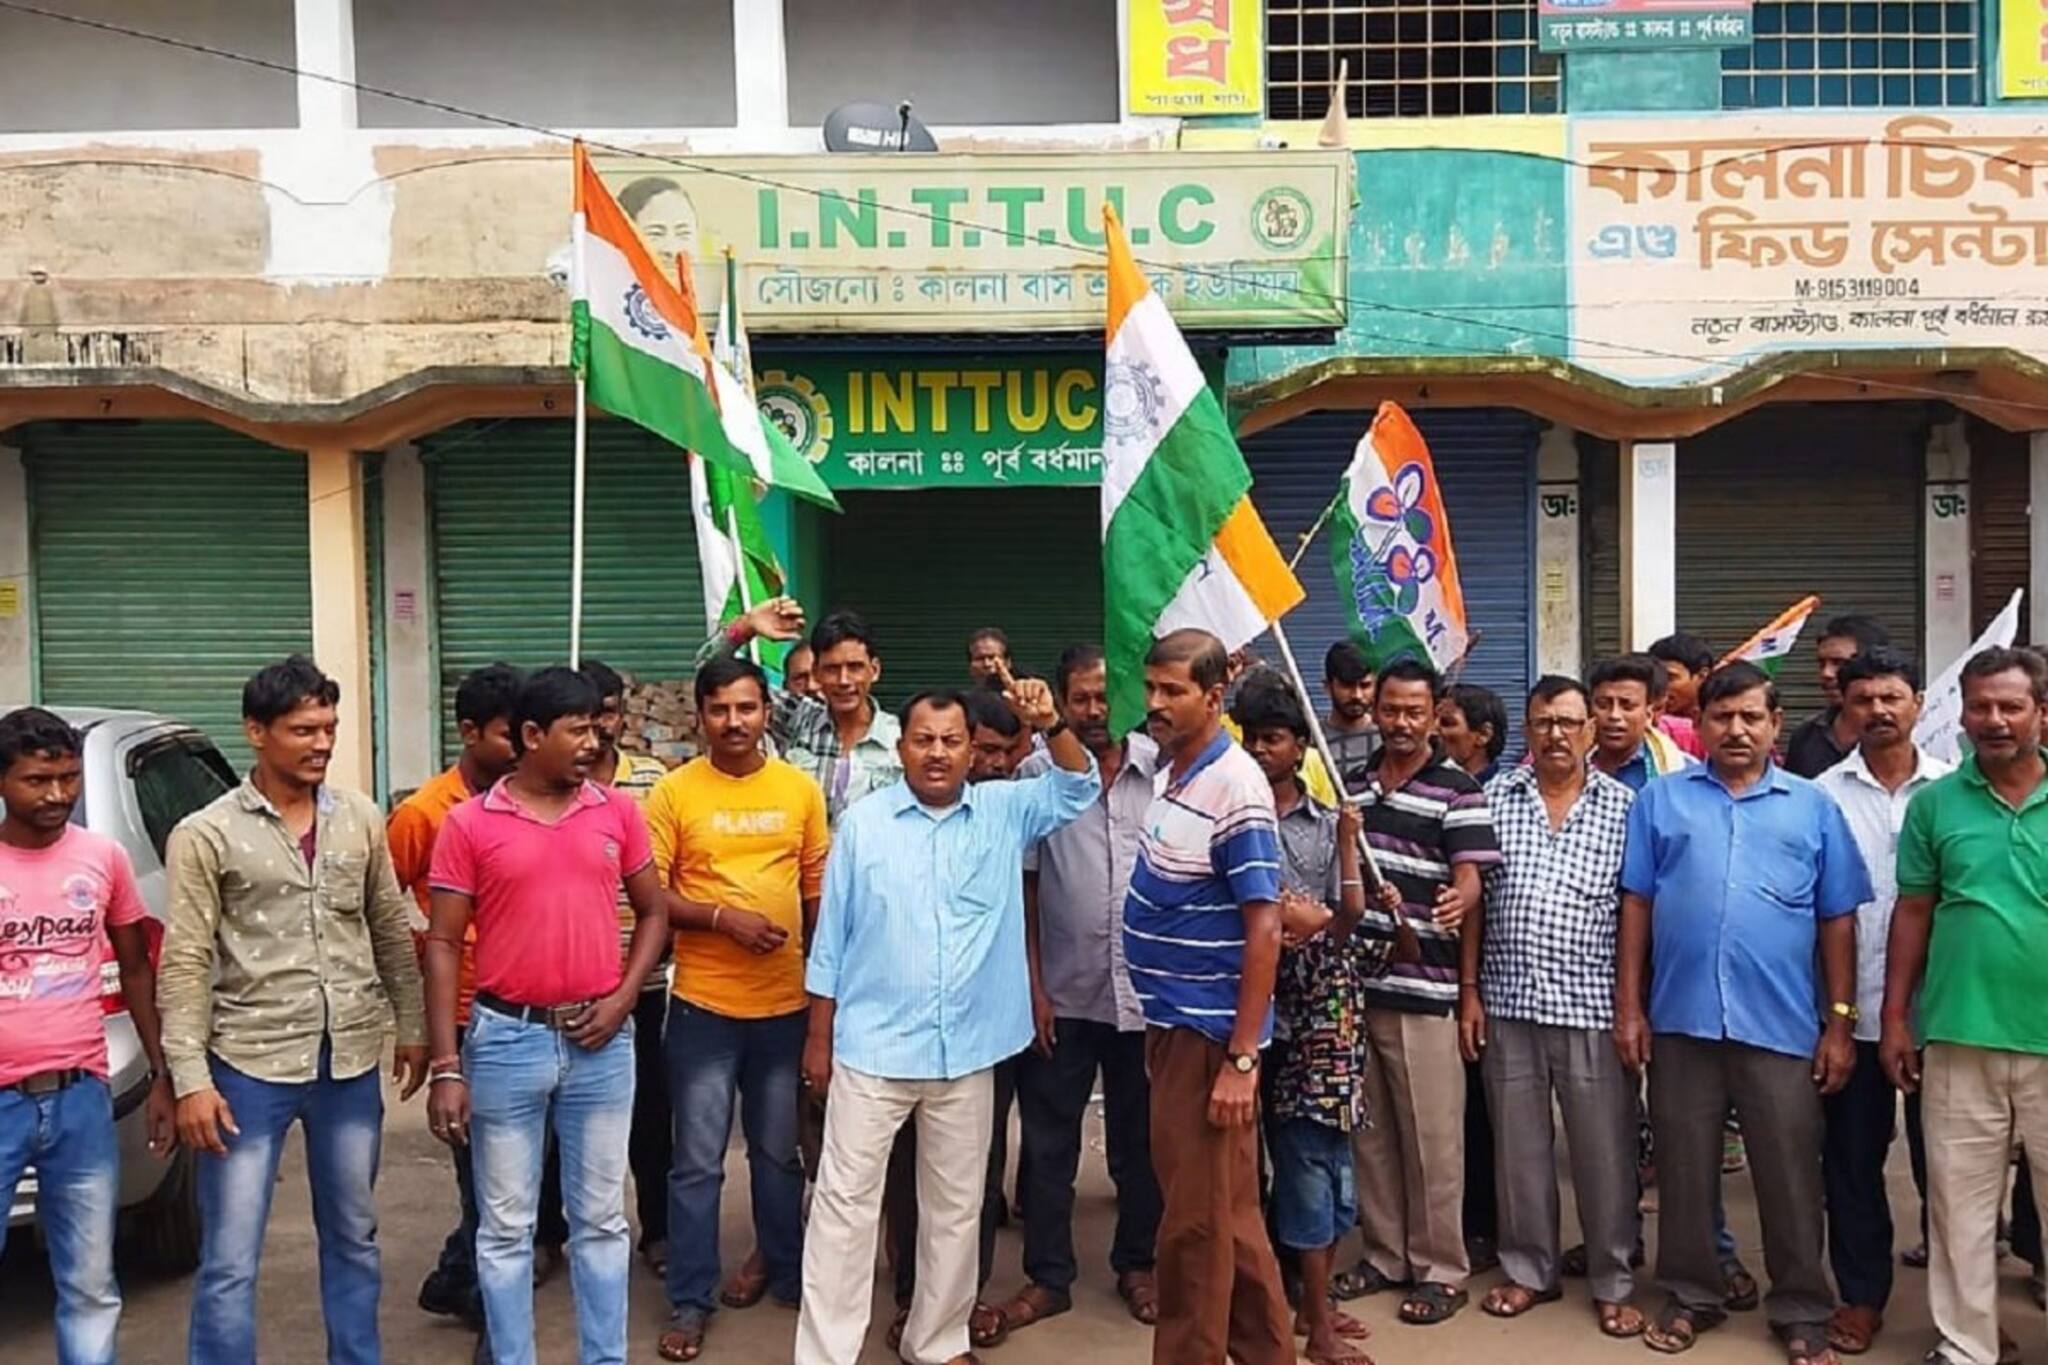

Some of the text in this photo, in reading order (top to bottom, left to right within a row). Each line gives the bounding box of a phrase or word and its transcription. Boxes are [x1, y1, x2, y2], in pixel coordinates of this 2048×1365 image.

[1588, 137, 1869, 204] কালনা
[757, 184, 1216, 249] I.N.T.T.U.C
[1692, 205, 1849, 270] ফিড
[915, 272, 1008, 304] কালনা
[1018, 273, 1072, 302] বাস
[1690, 316, 1744, 345] নতুন
[847, 368, 1098, 434] INTTUC
[844, 447, 924, 477] কালনা
[981, 440, 1027, 481] পূর্ব
